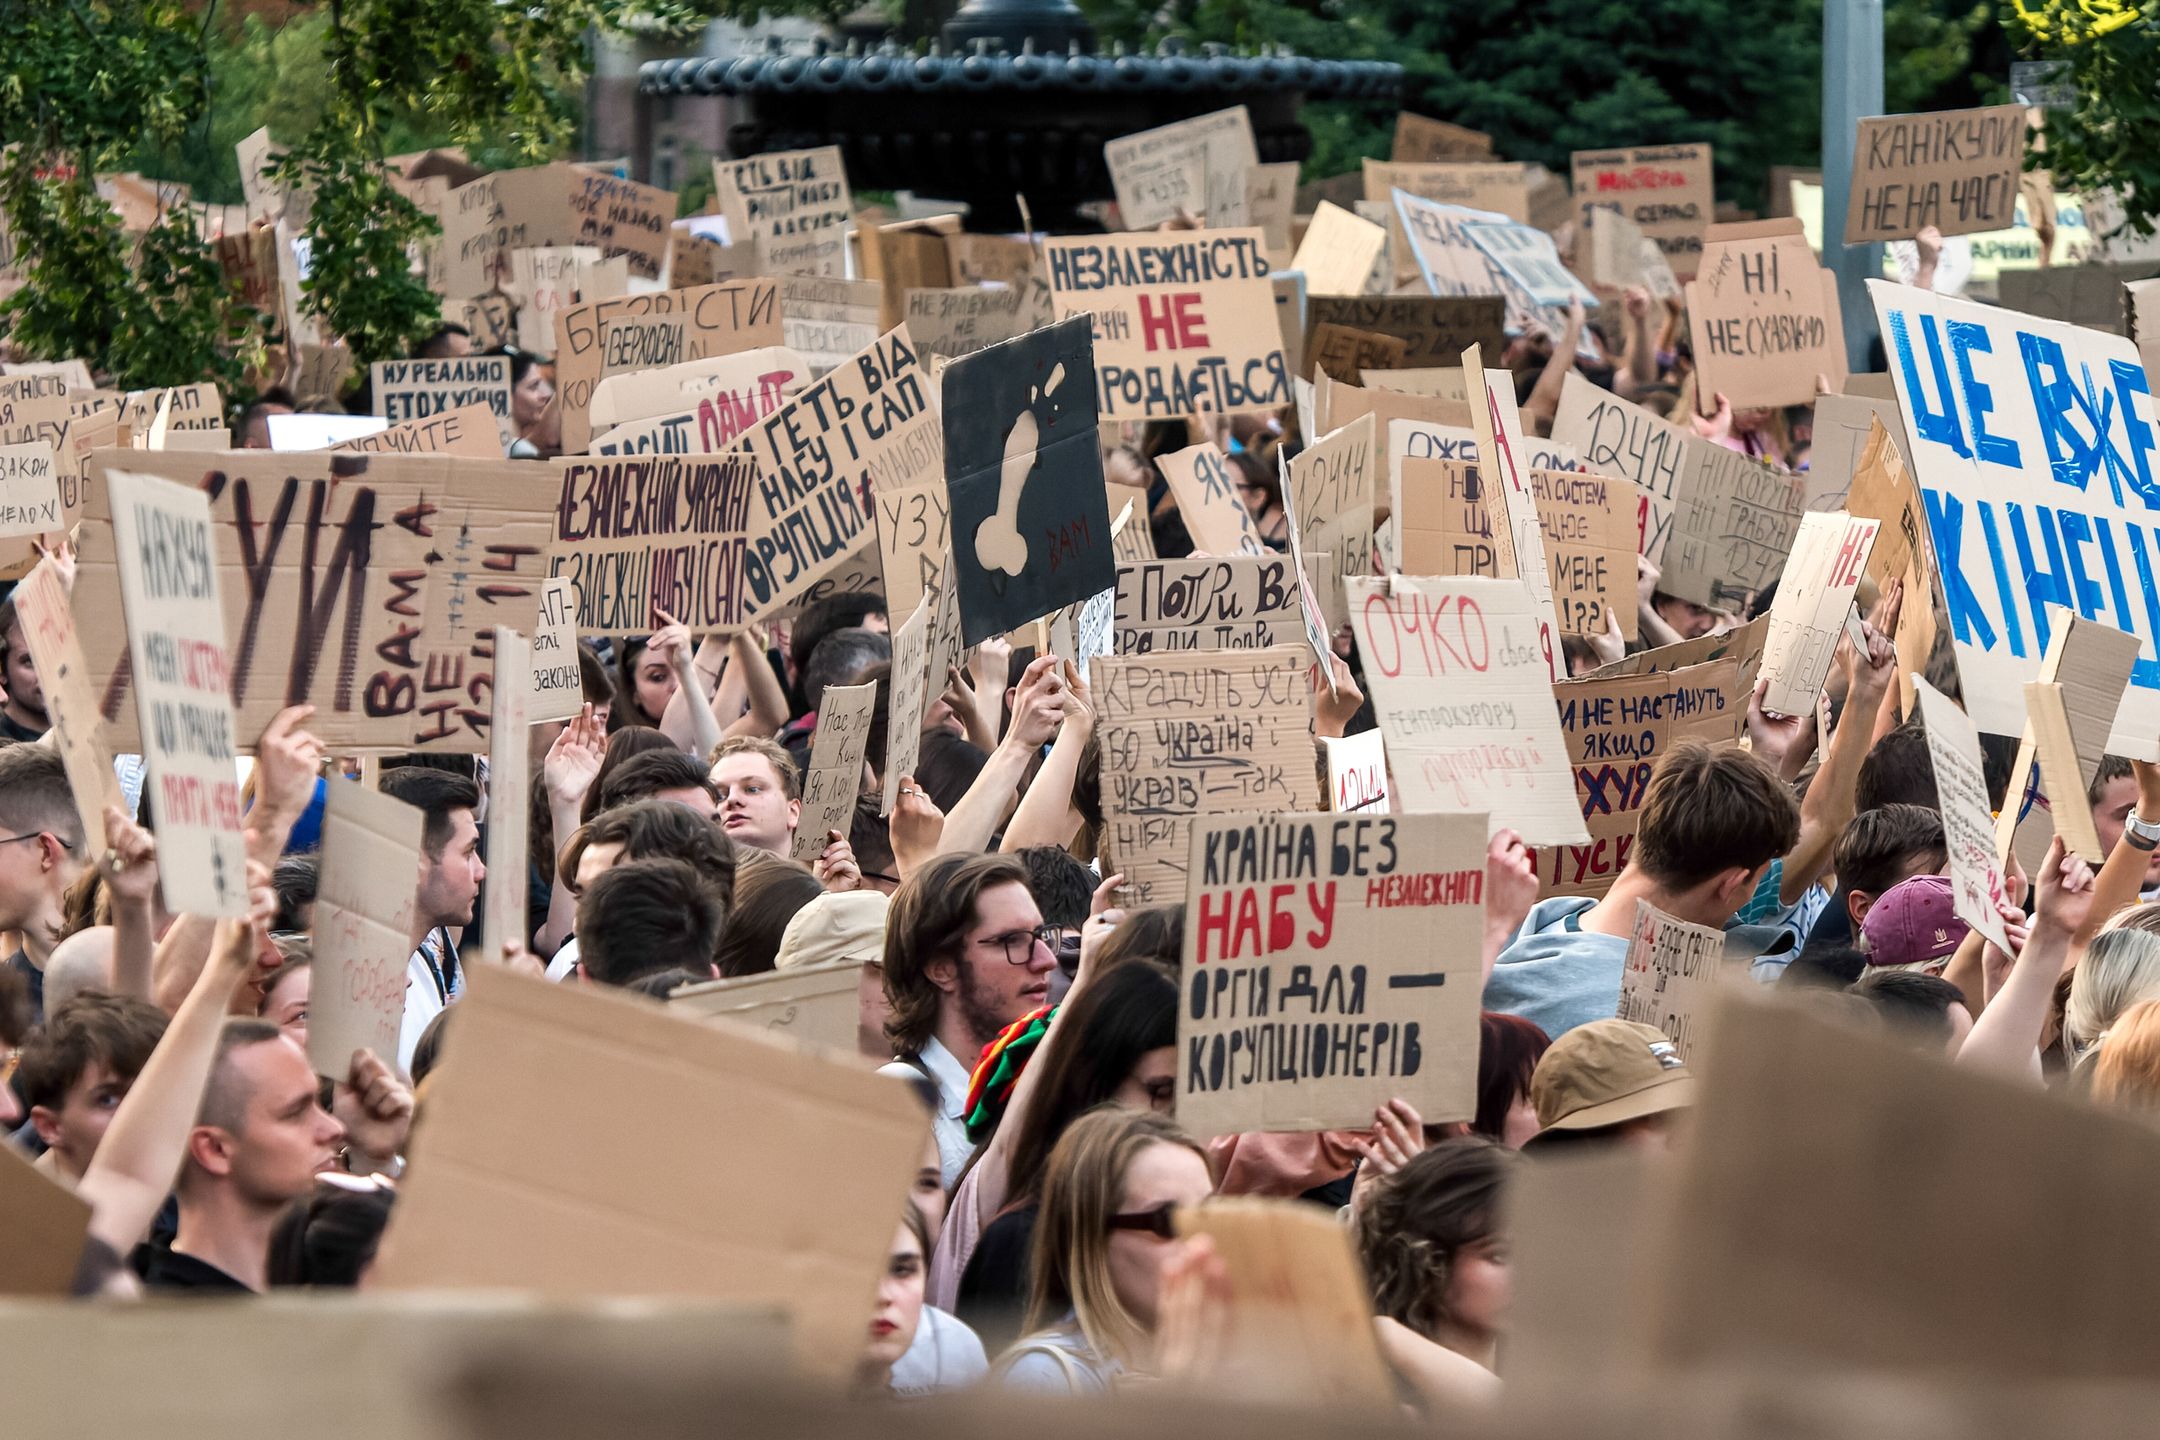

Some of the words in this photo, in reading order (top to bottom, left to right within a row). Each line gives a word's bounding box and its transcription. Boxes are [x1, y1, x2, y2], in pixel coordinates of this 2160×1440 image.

[1861, 184, 1902, 232] НЕ
[1904, 181, 1941, 229] НА
[1950, 170, 2010, 222] ЧАСІ
[1048, 237, 1270, 292] НЕЗАЛЕЖНІСТЬ
[607, 323, 684, 368] ВЕРХОВНА
[1137, 291, 1212, 352] НЕ
[1706, 318, 1744, 356] НЕ
[764, 376, 856, 465] ГЕТЬ
[857, 334, 918, 396] ВІД
[1097, 350, 1292, 416] РОДАЄТЬСЯ
[1887, 308, 2024, 470] ЦЕ
[2016, 330, 2160, 511] ВЖЕ
[758, 435, 834, 519] НАБУ
[860, 372, 926, 441] САП
[1583, 400, 1684, 500] 12414
[681, 455, 757, 533] УКРАЇНІ
[101, 456, 376, 722] УЙ
[550, 546, 651, 630] ЗАЛЕЖНІ
[650, 545, 697, 630] НАБУ
[704, 537, 748, 626] САП
[1554, 551, 1608, 593] МЕНЕ
[1827, 523, 1875, 589] НЕ
[1363, 591, 1489, 679] ОЧКО
[413, 651, 466, 744] НЕ
[1582, 697, 1613, 730] НЕ
[1620, 685, 1726, 725] НАСТАНУТЬ
[1582, 728, 1656, 761] ЯКЩО
[1203, 816, 1318, 885] КРАЇНА
[1329, 818, 1398, 877] БЕЗ
[1196, 880, 1338, 964] НАБУ
[1189, 965, 1270, 1020] ОРГІЯ
[1278, 964, 1367, 1015] ДЛЯ
[1187, 1021, 1423, 1094] КОРУПЦІОНЕРІВ
